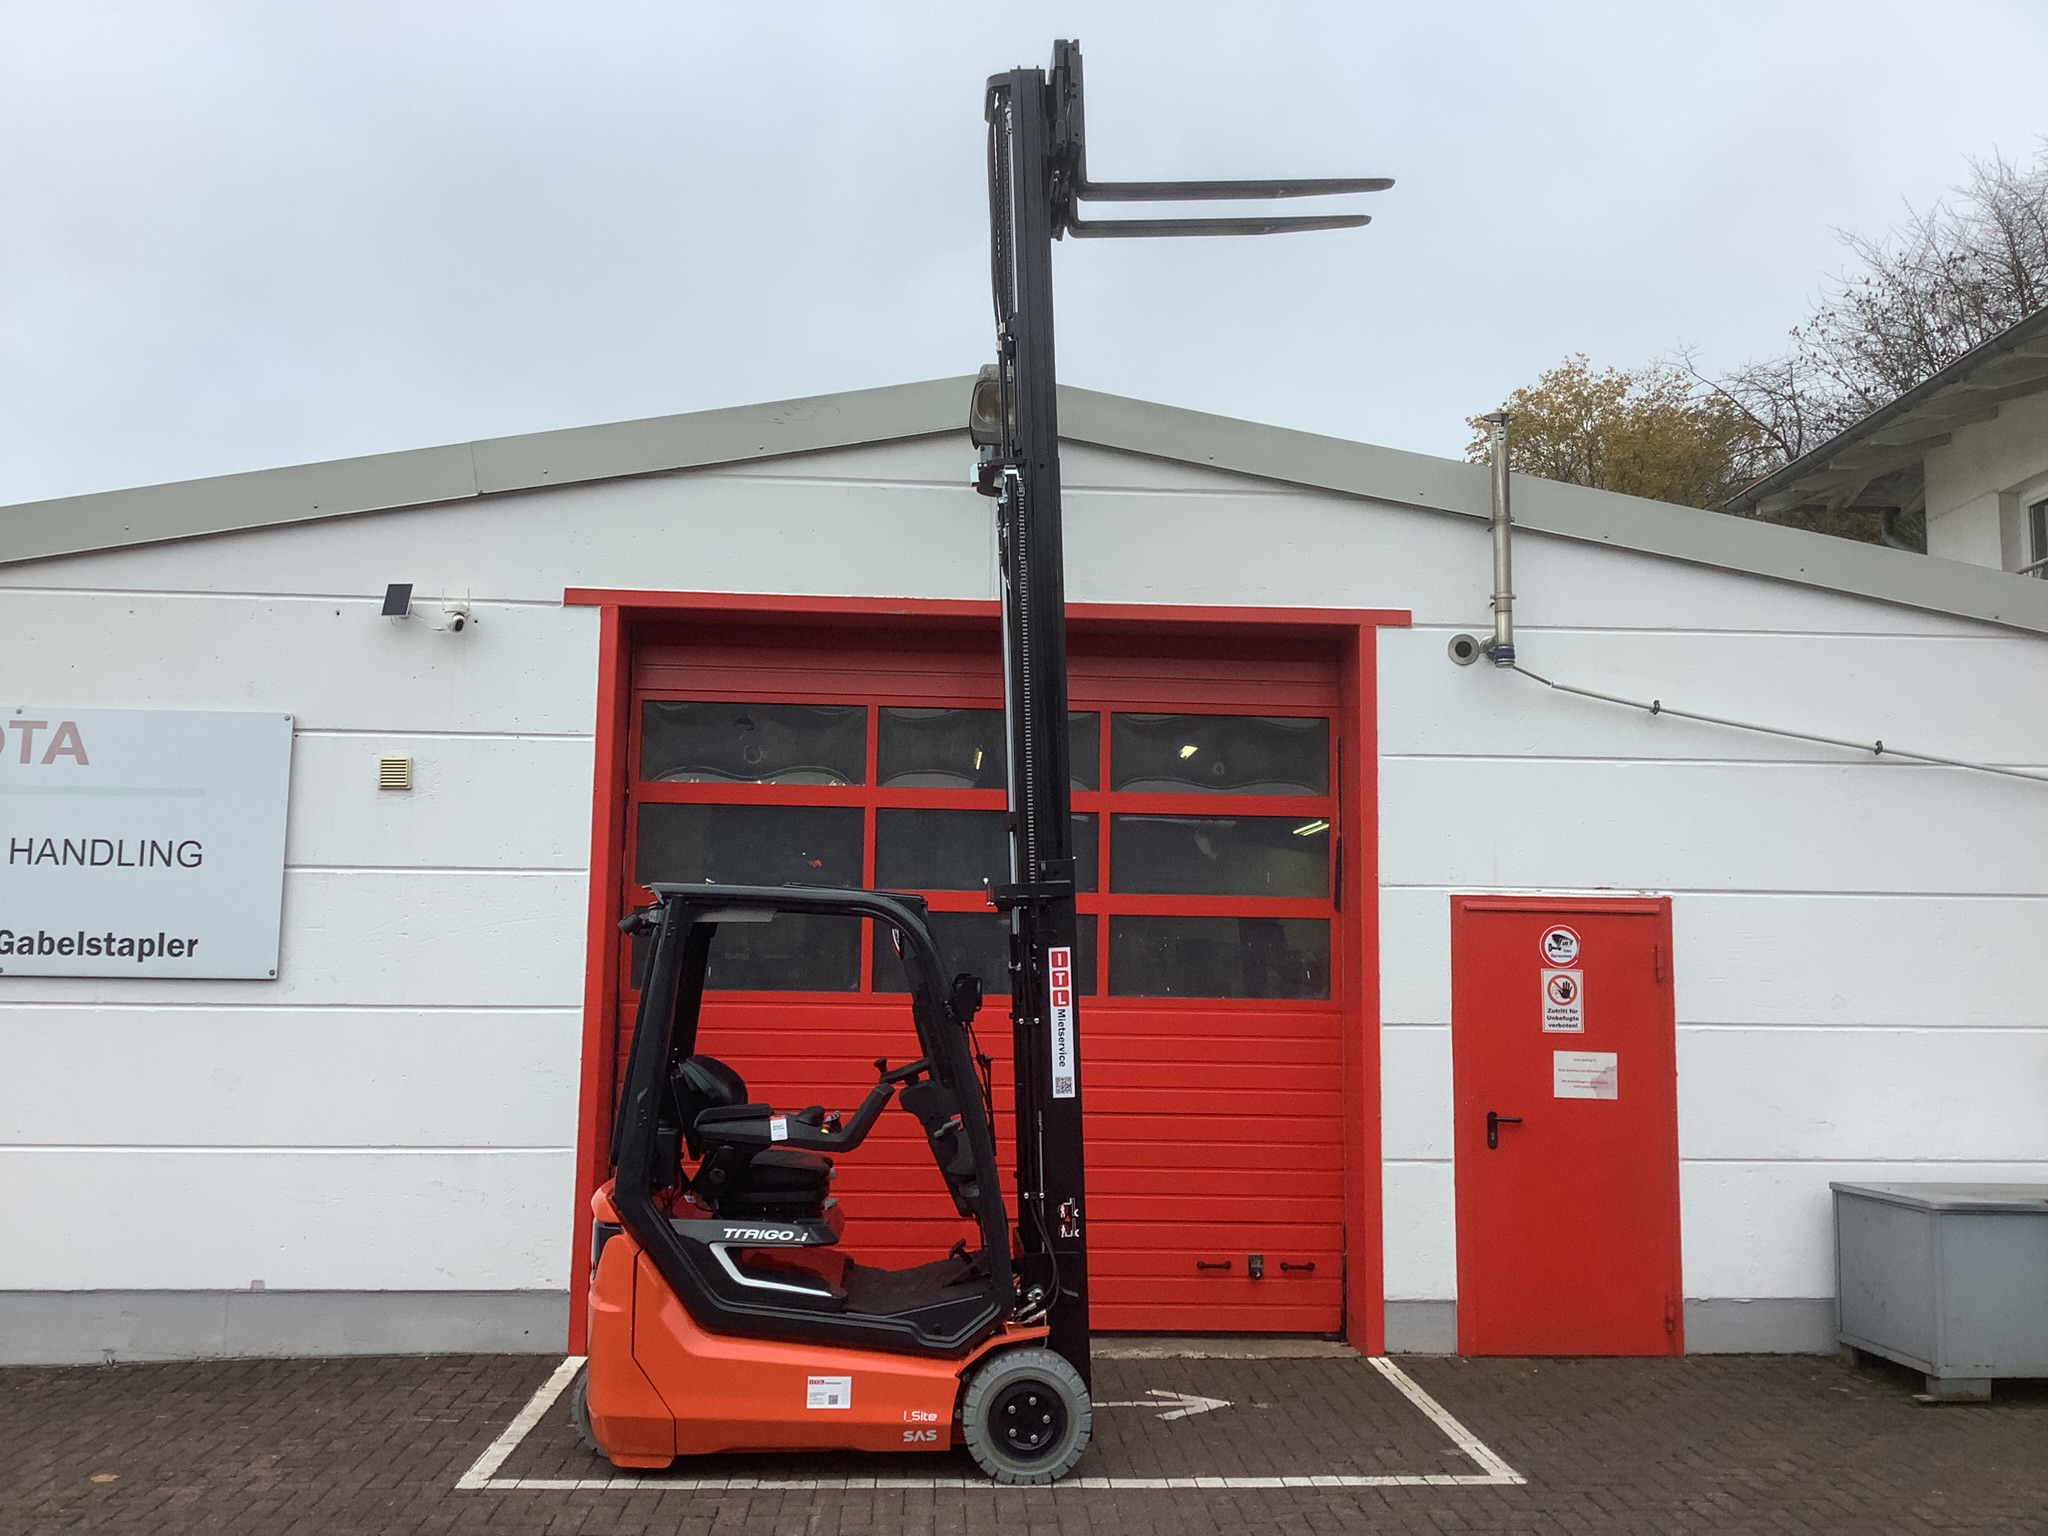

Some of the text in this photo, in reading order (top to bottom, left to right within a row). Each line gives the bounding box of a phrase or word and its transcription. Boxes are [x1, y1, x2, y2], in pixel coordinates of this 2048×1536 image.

[0, 719, 90, 766] TA
[9, 837, 204, 869] HANDLING
[0, 929, 199, 963] Gabelstapler
[1057, 1009, 1068, 1067] Mietservice
[903, 1429, 938, 1442] SAS
